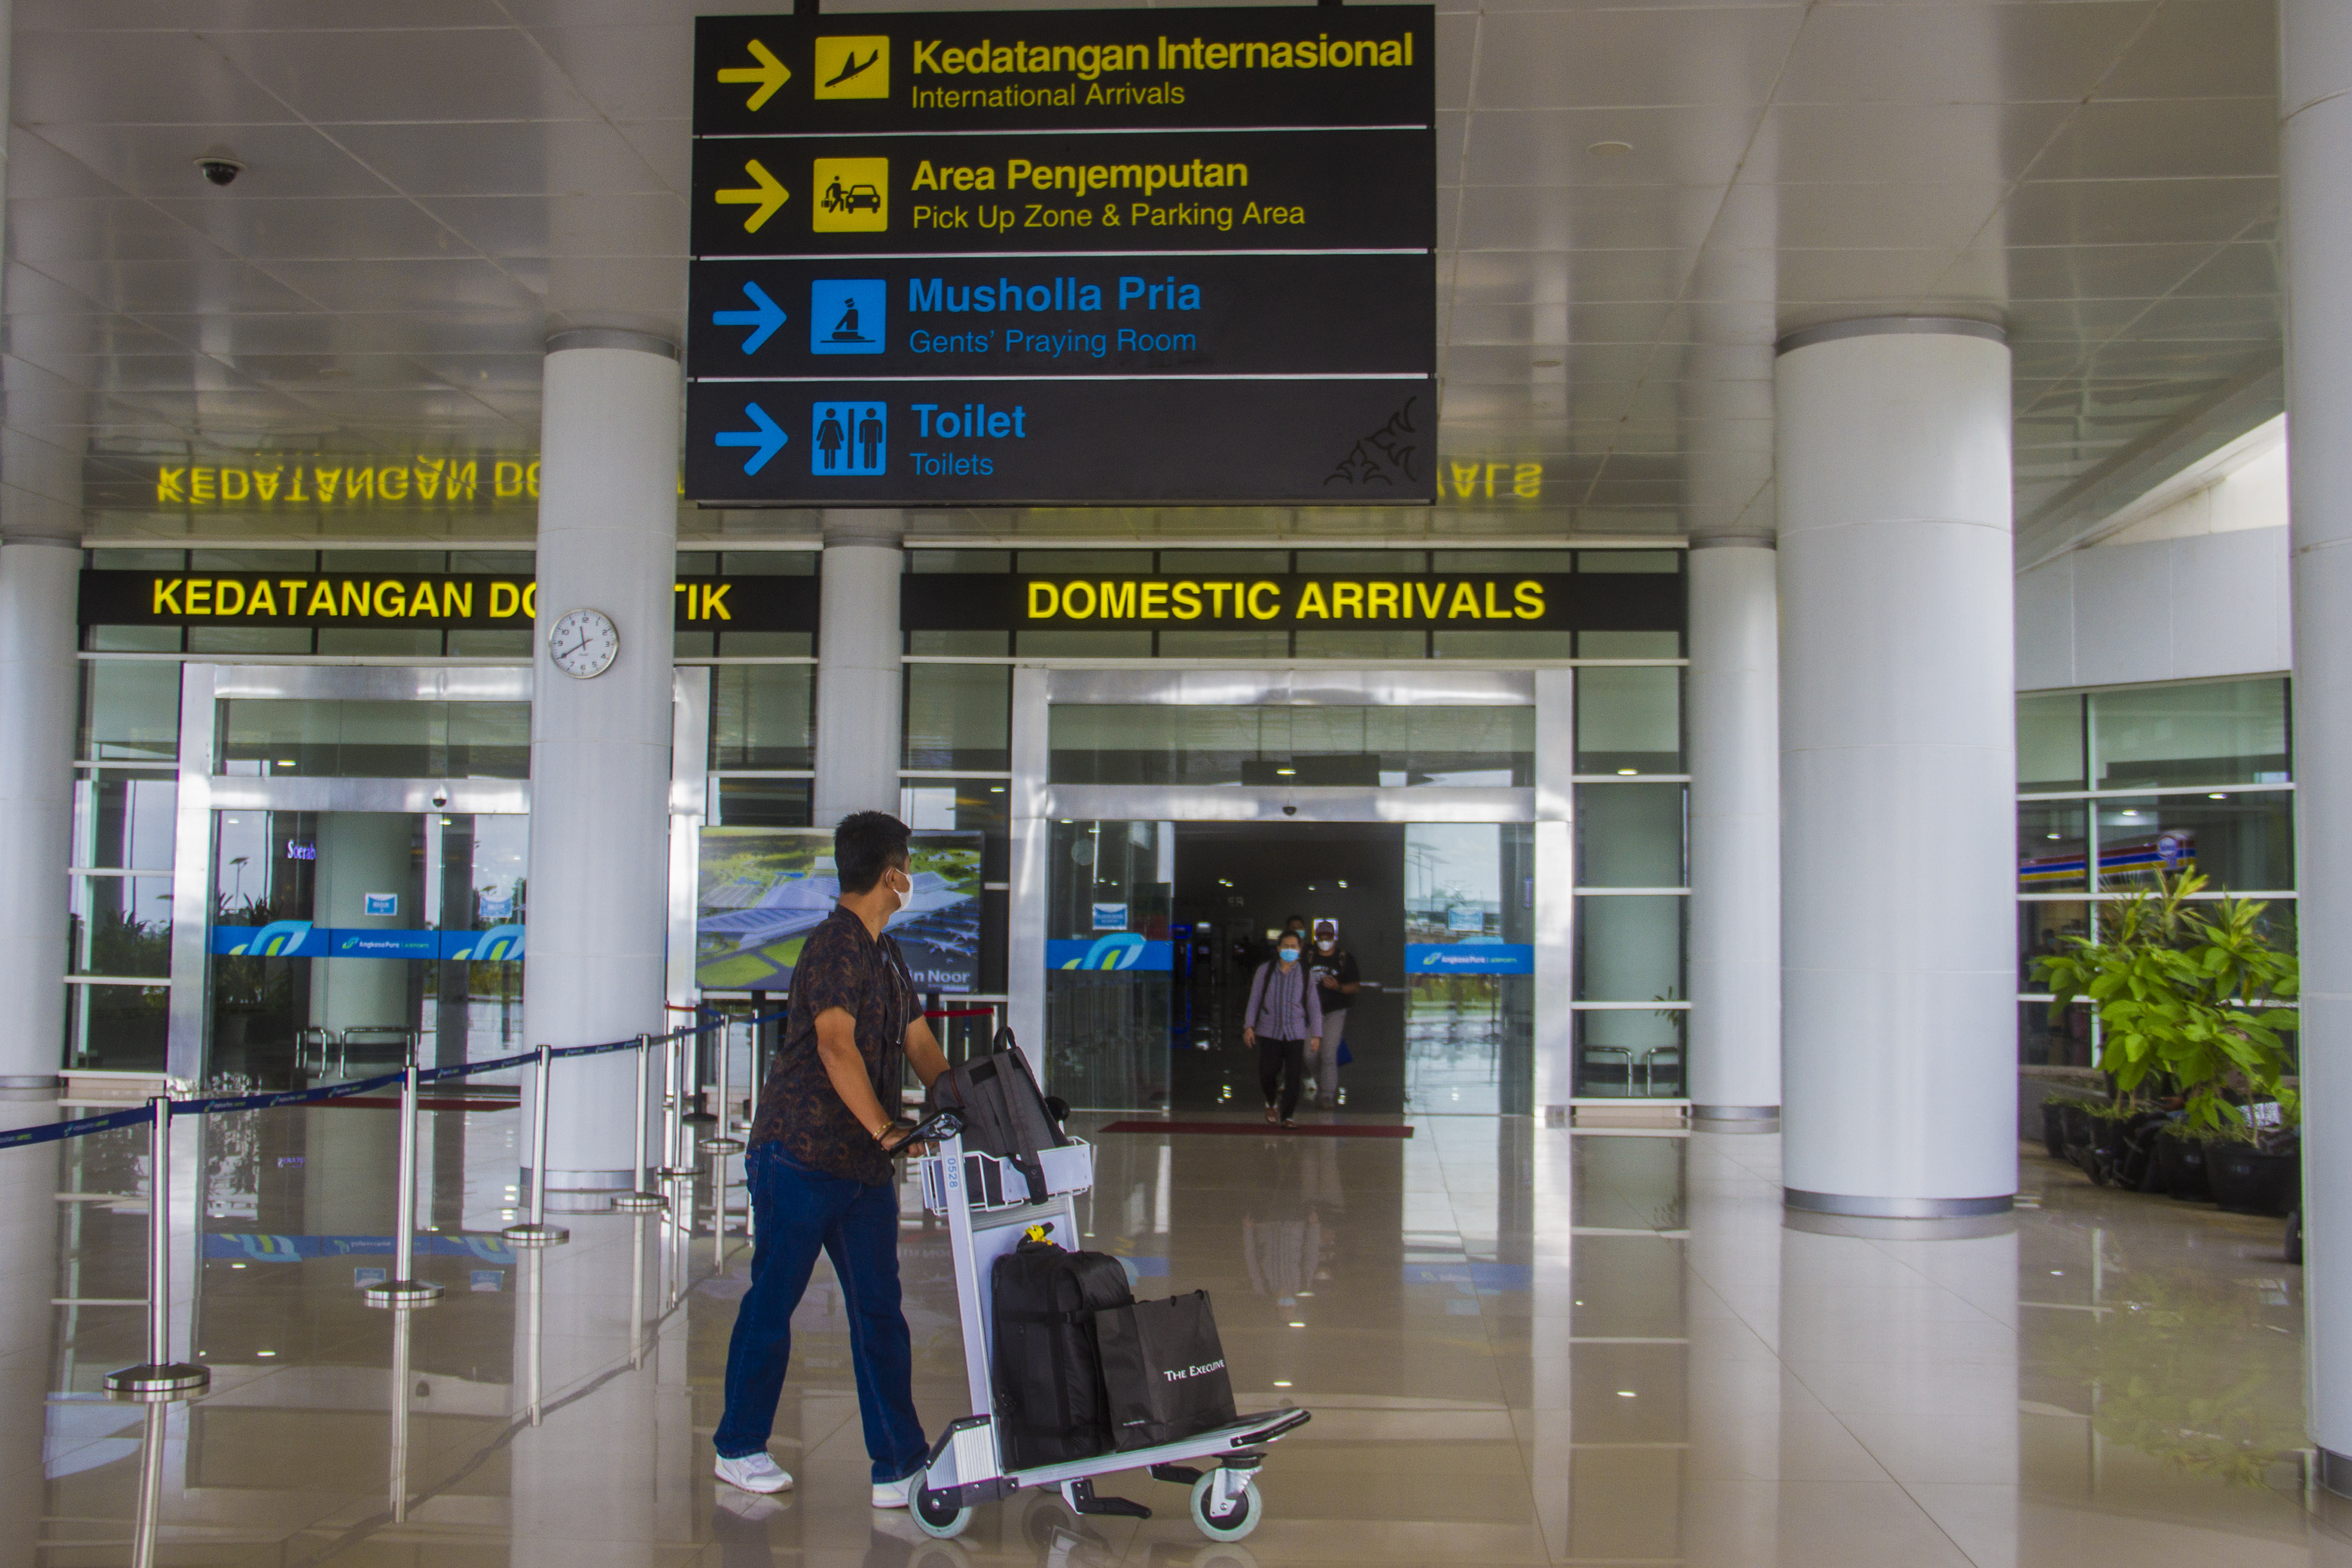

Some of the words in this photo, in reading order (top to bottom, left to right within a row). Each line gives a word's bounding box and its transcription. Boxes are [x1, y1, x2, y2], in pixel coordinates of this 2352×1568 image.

[914, 39, 1150, 80] Kedatangan
[1158, 32, 1414, 70] Internasional
[913, 83, 1076, 109] International
[1085, 81, 1185, 106] Arrivals
[911, 161, 996, 192] Area
[1008, 159, 1249, 198] Penjemputan
[914, 206, 969, 229] Pick
[979, 206, 1015, 234] Up
[1024, 205, 1093, 228] Zone
[1102, 204, 1121, 227] &
[1132, 203, 1234, 232] Parking
[1242, 202, 1306, 225] Area
[909, 276, 1103, 313] Musholla
[1119, 276, 1202, 312] Pria
[910, 329, 996, 354] Gents’
[1006, 329, 1108, 359] Praying
[1118, 328, 1197, 352] Room
[911, 403, 1027, 440] Toilet
[910, 452, 995, 477] Toilets
[153, 578, 473, 618] KEDATANGAN
[1027, 581, 1282, 621] DOMESTIC
[1295, 580, 1546, 621] ARRIVALS
[927, 969, 971, 983] Noor
[947, 1158, 958, 1188] 0528
[1164, 1370, 1187, 1382] THE
